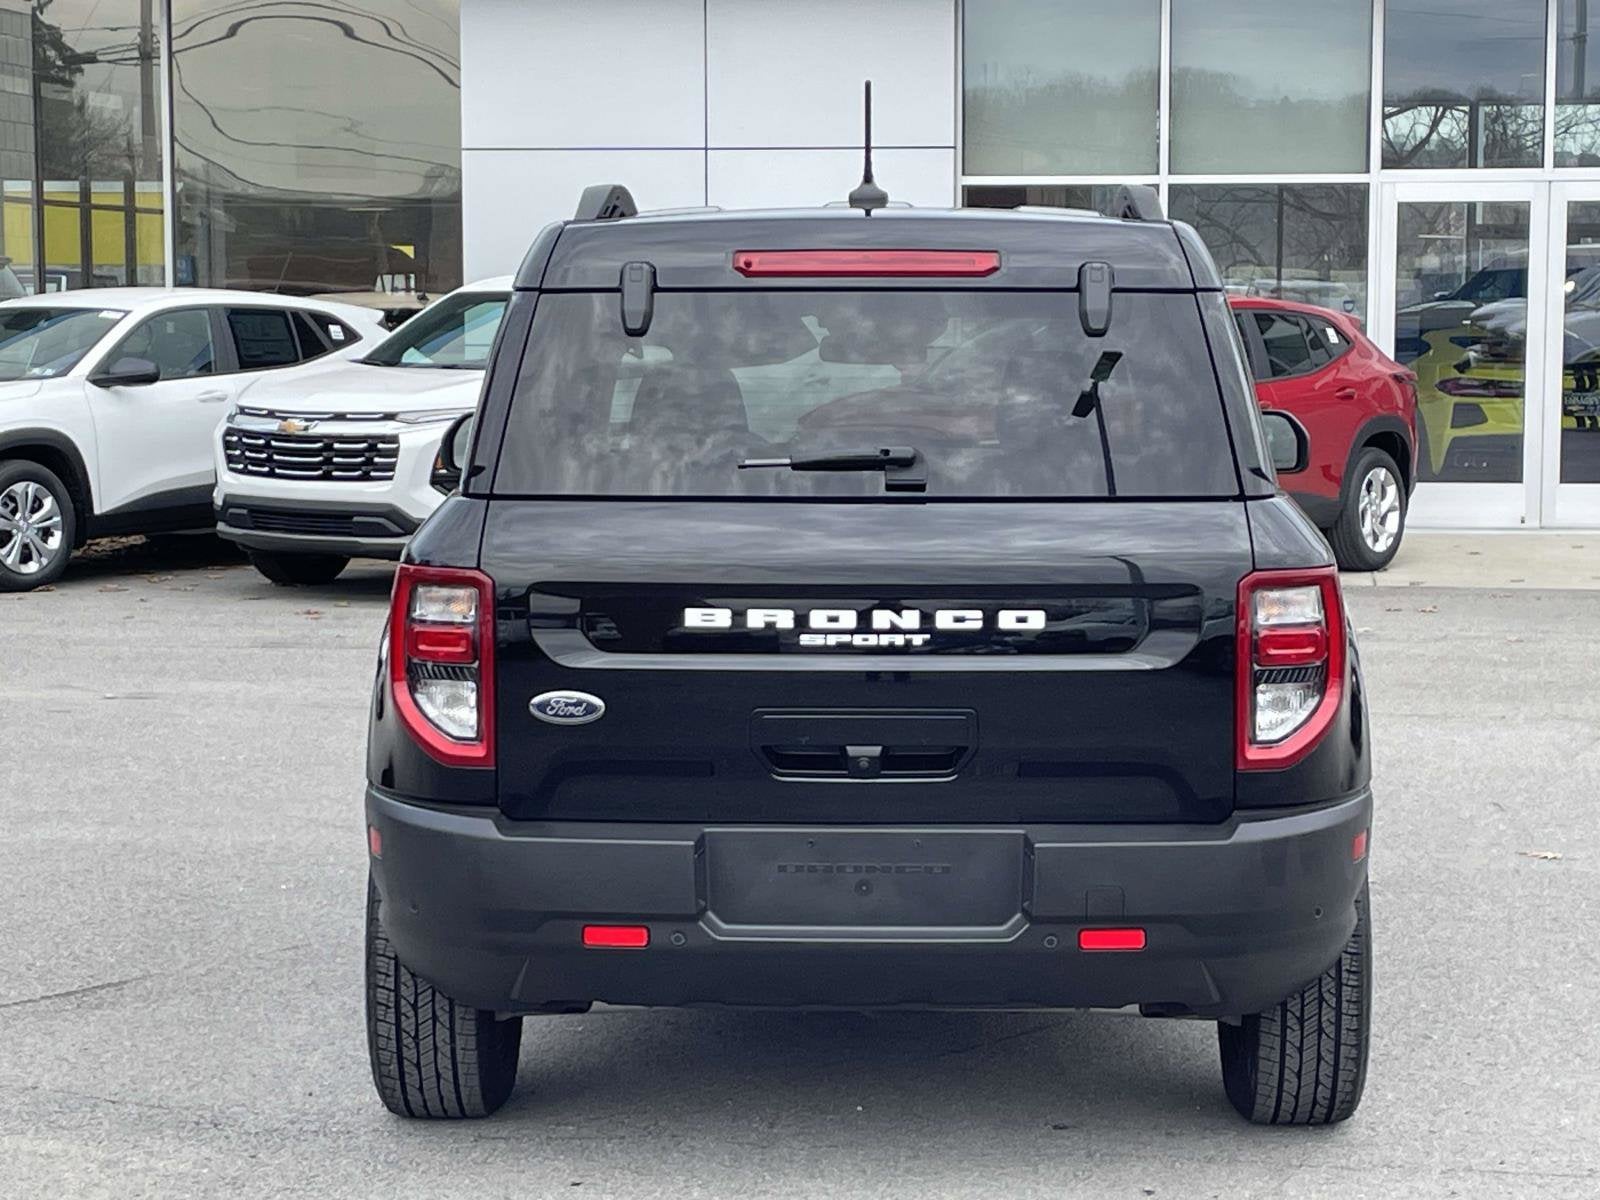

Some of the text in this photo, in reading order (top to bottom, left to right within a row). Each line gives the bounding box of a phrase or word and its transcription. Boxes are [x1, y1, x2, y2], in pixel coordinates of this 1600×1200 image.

[683, 607, 1046, 630] BRONCO
[799, 633, 931, 647] SPORT
[546, 697, 588, 716] Ford
